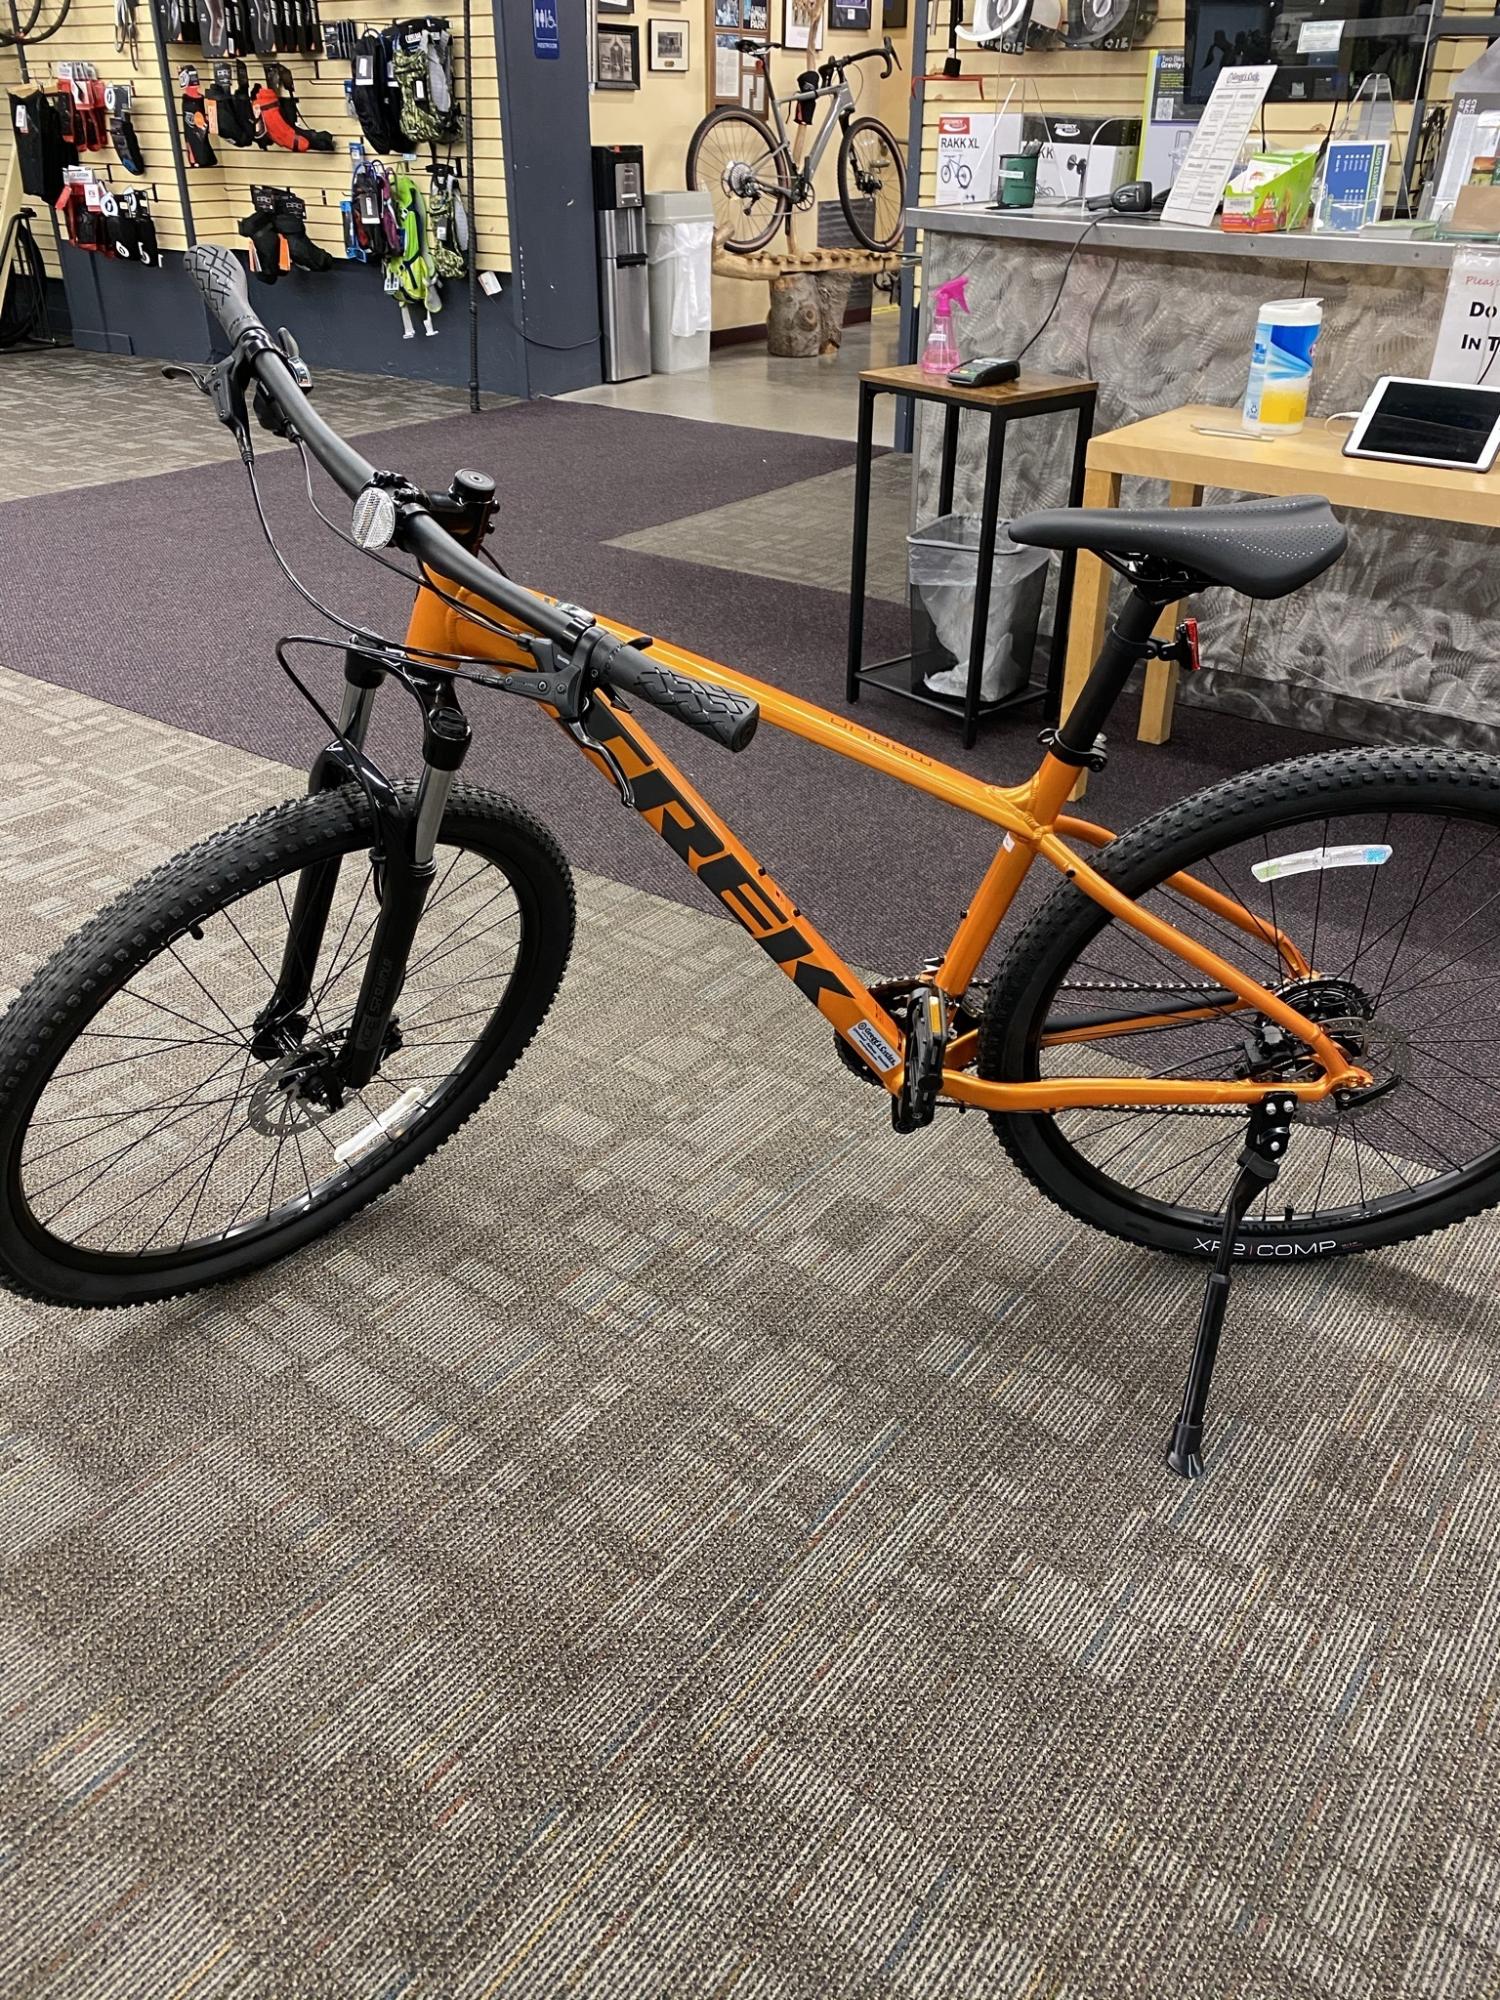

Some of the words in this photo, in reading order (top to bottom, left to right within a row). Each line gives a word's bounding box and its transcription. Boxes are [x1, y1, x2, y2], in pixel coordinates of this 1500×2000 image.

[940, 138, 967, 149] RAKK
[968, 139, 980, 150] XL
[586, 693, 853, 1007] TREK
[1256, 1240, 1338, 1257] COMP
